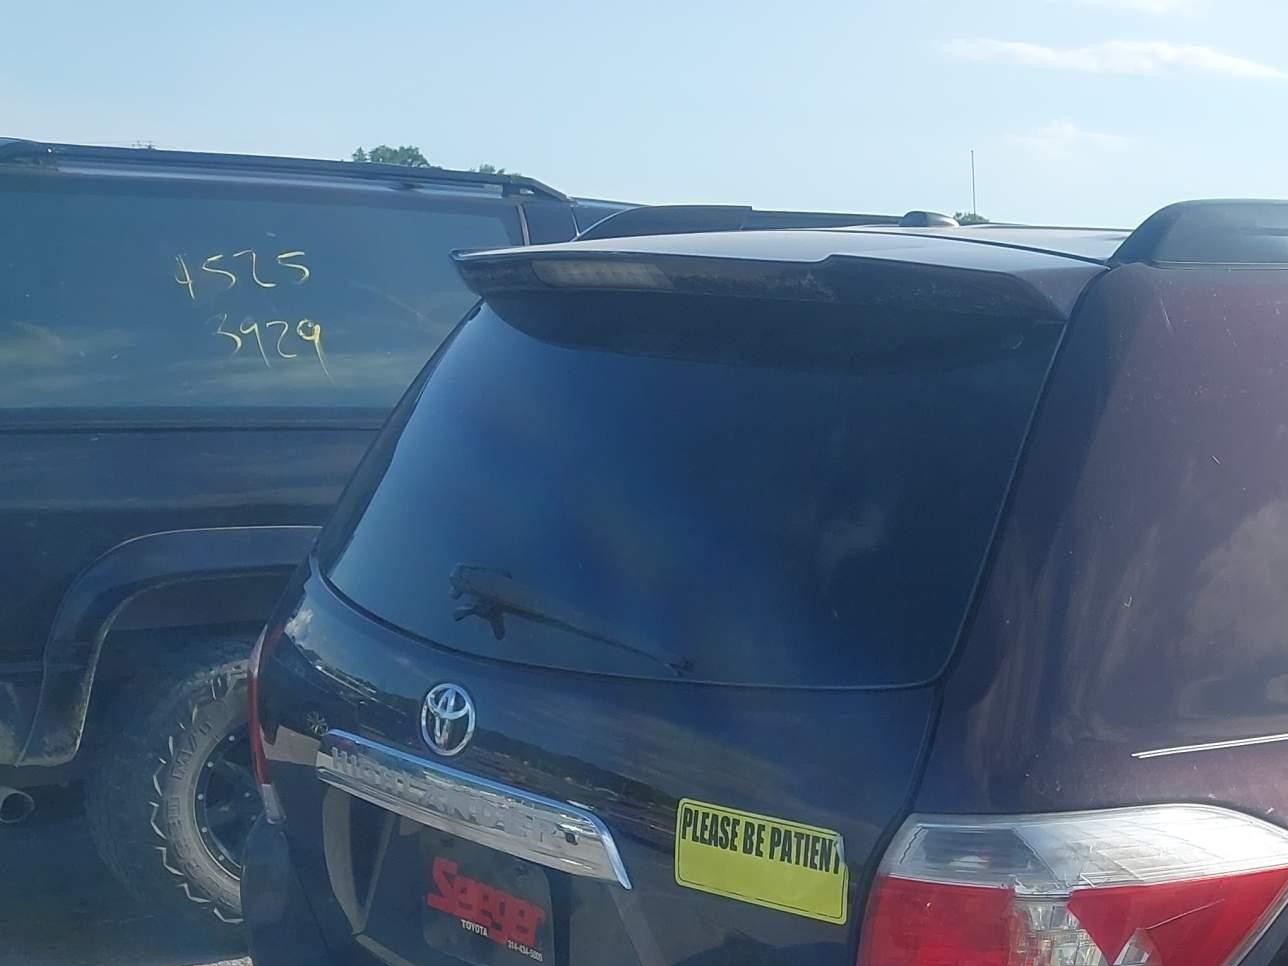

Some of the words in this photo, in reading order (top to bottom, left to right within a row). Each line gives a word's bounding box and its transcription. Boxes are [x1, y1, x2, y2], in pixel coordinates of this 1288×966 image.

[175, 250, 310, 303] 4525
[208, 314, 334, 383] 3929
[681, 807, 741, 852] PLEASE
[742, 821, 766, 858] BE
[460, 918, 489, 938] TOYOTA
